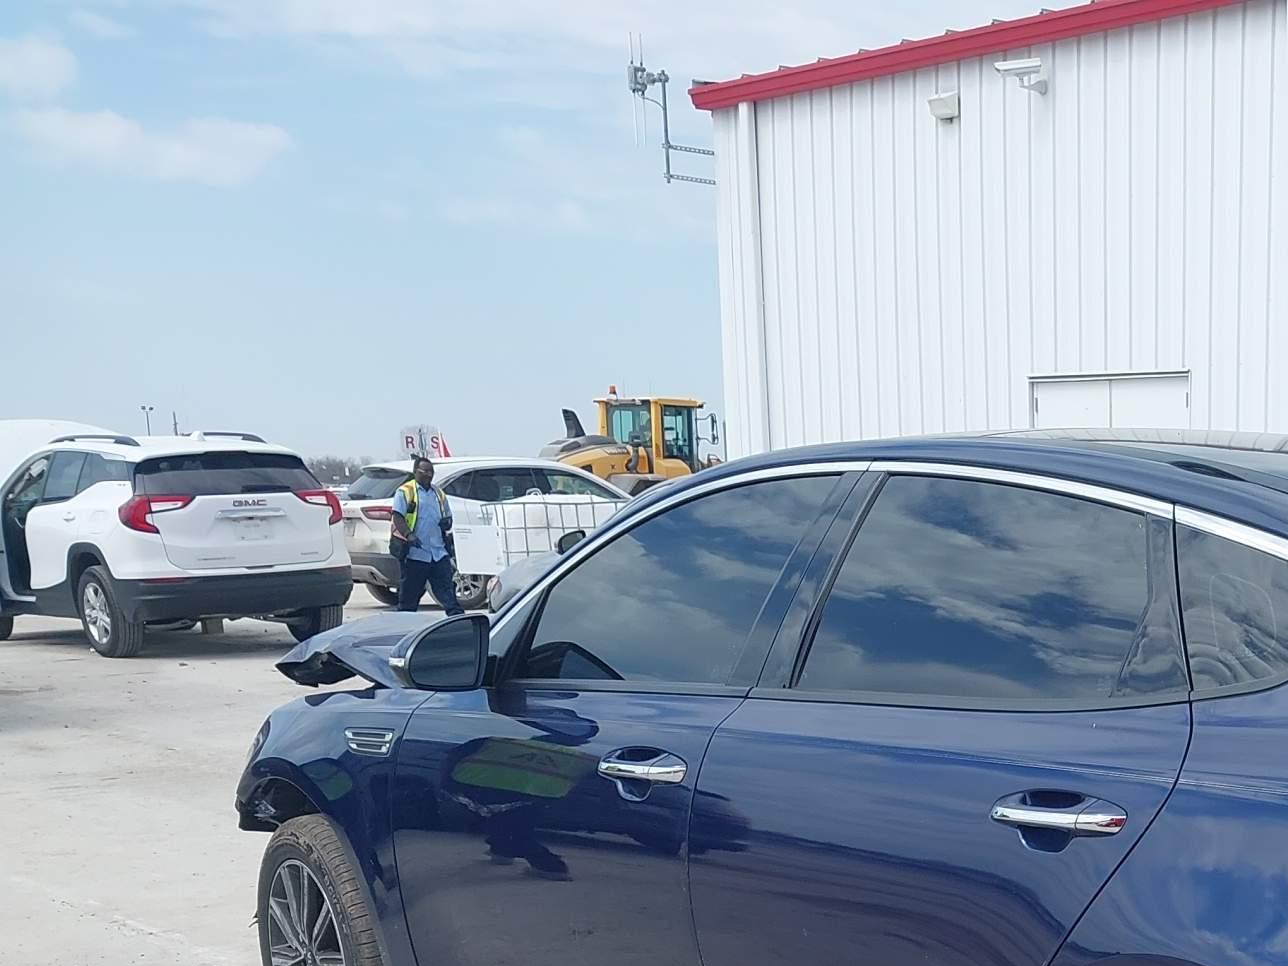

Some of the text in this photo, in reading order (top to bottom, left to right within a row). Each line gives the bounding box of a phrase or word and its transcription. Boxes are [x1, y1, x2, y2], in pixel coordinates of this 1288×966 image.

[405, 435, 439, 449] R S
[232, 499, 267, 507] GMC
